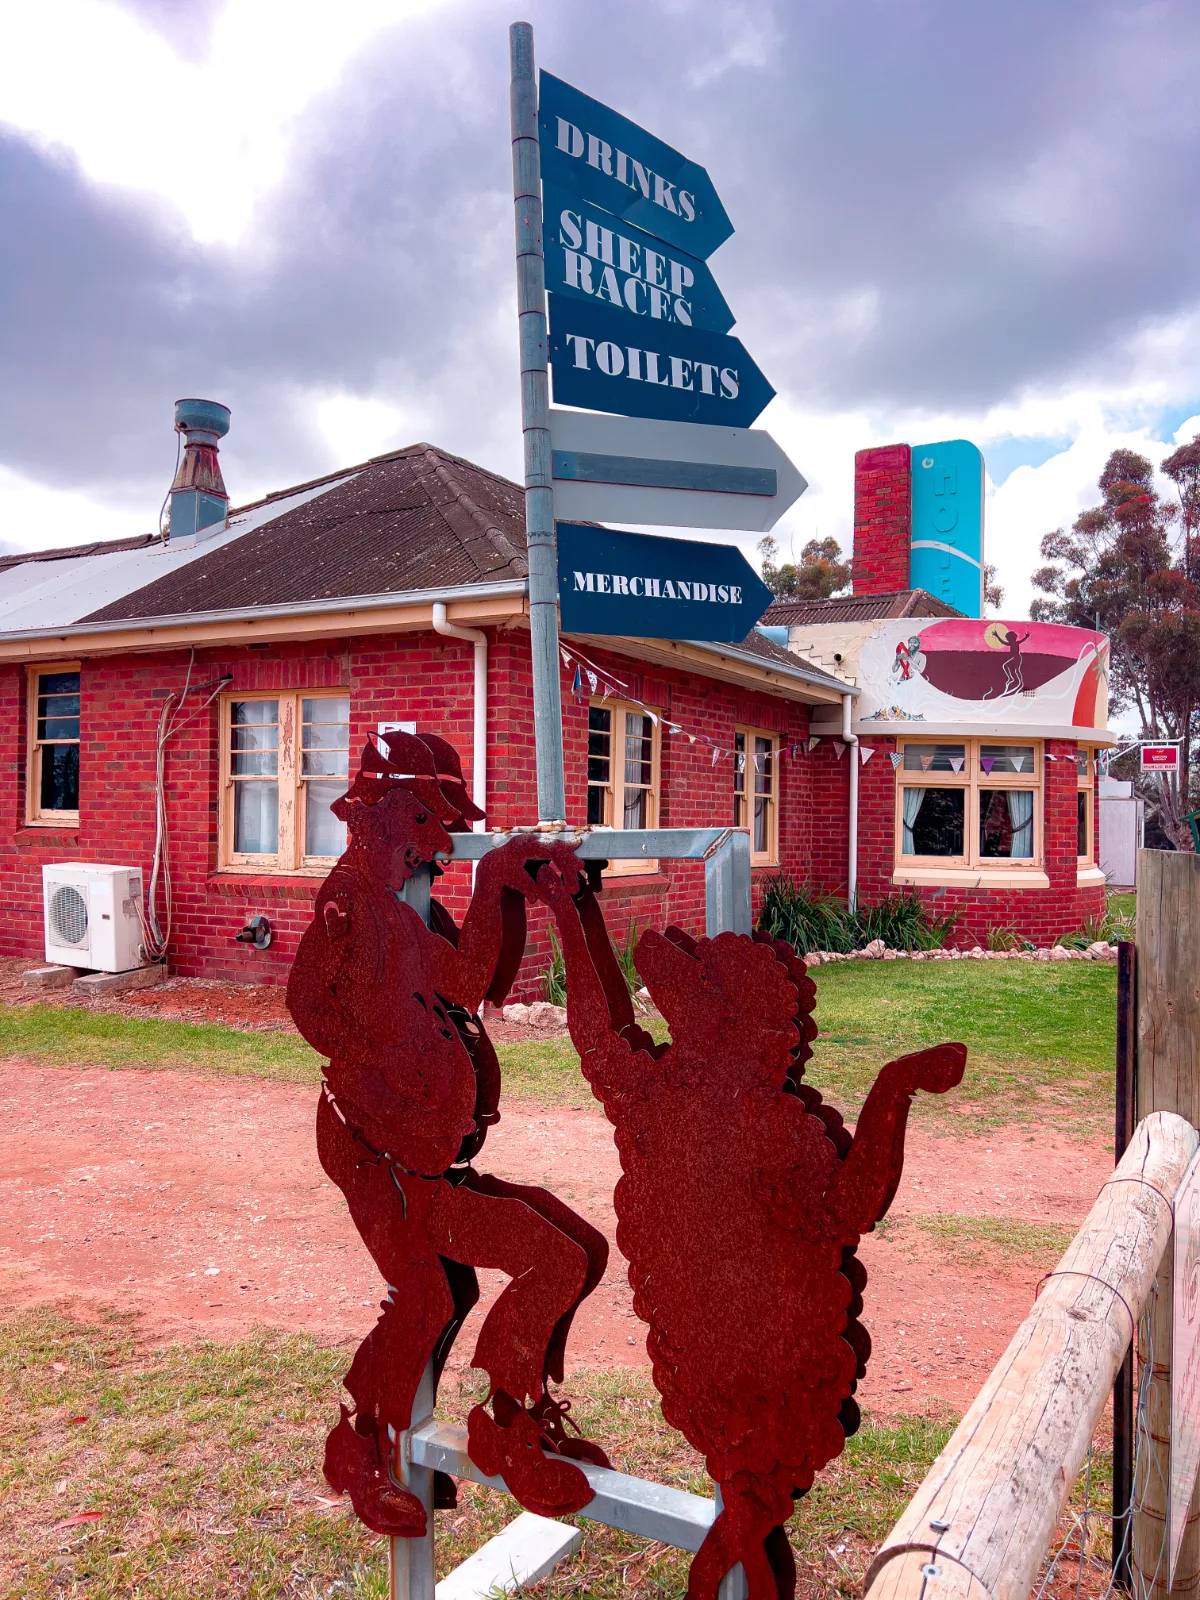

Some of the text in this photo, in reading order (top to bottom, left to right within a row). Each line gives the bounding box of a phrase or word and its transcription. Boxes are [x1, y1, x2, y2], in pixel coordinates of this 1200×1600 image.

[555, 116, 695, 222] DRINKS
[559, 209, 694, 298] SHEEP
[562, 247, 693, 326] RACES
[566, 333, 739, 399] TOILETS
[933, 464, 958, 605] HOTE
[573, 571, 743, 604] MERCHANDISE
